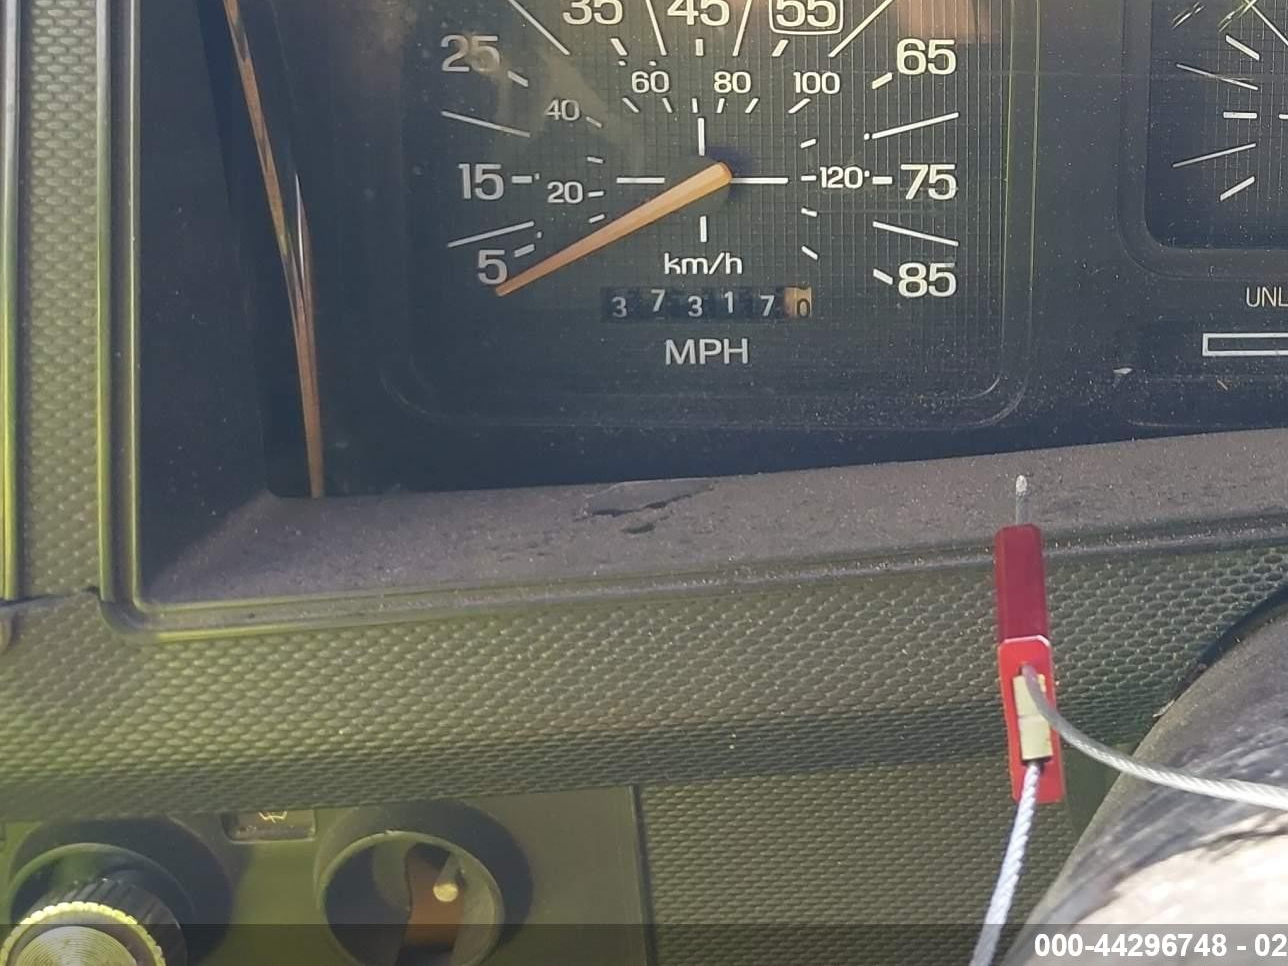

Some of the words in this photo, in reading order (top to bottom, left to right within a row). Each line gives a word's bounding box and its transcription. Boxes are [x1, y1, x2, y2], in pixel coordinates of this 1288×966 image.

[441, 35, 499, 72] 25
[897, 39, 956, 75] 65
[631, 71, 669, 94] 60
[713, 71, 751, 94] 80
[793, 72, 840, 95] 100
[544, 100, 580, 122] 40
[458, 163, 504, 199] 15
[820, 167, 863, 189] 120
[901, 165, 956, 200] 75
[547, 182, 584, 203] 20
[477, 250, 508, 285] 5
[664, 254, 743, 276] km/h
[898, 263, 956, 298] 85
[664, 339, 749, 364] MPH
